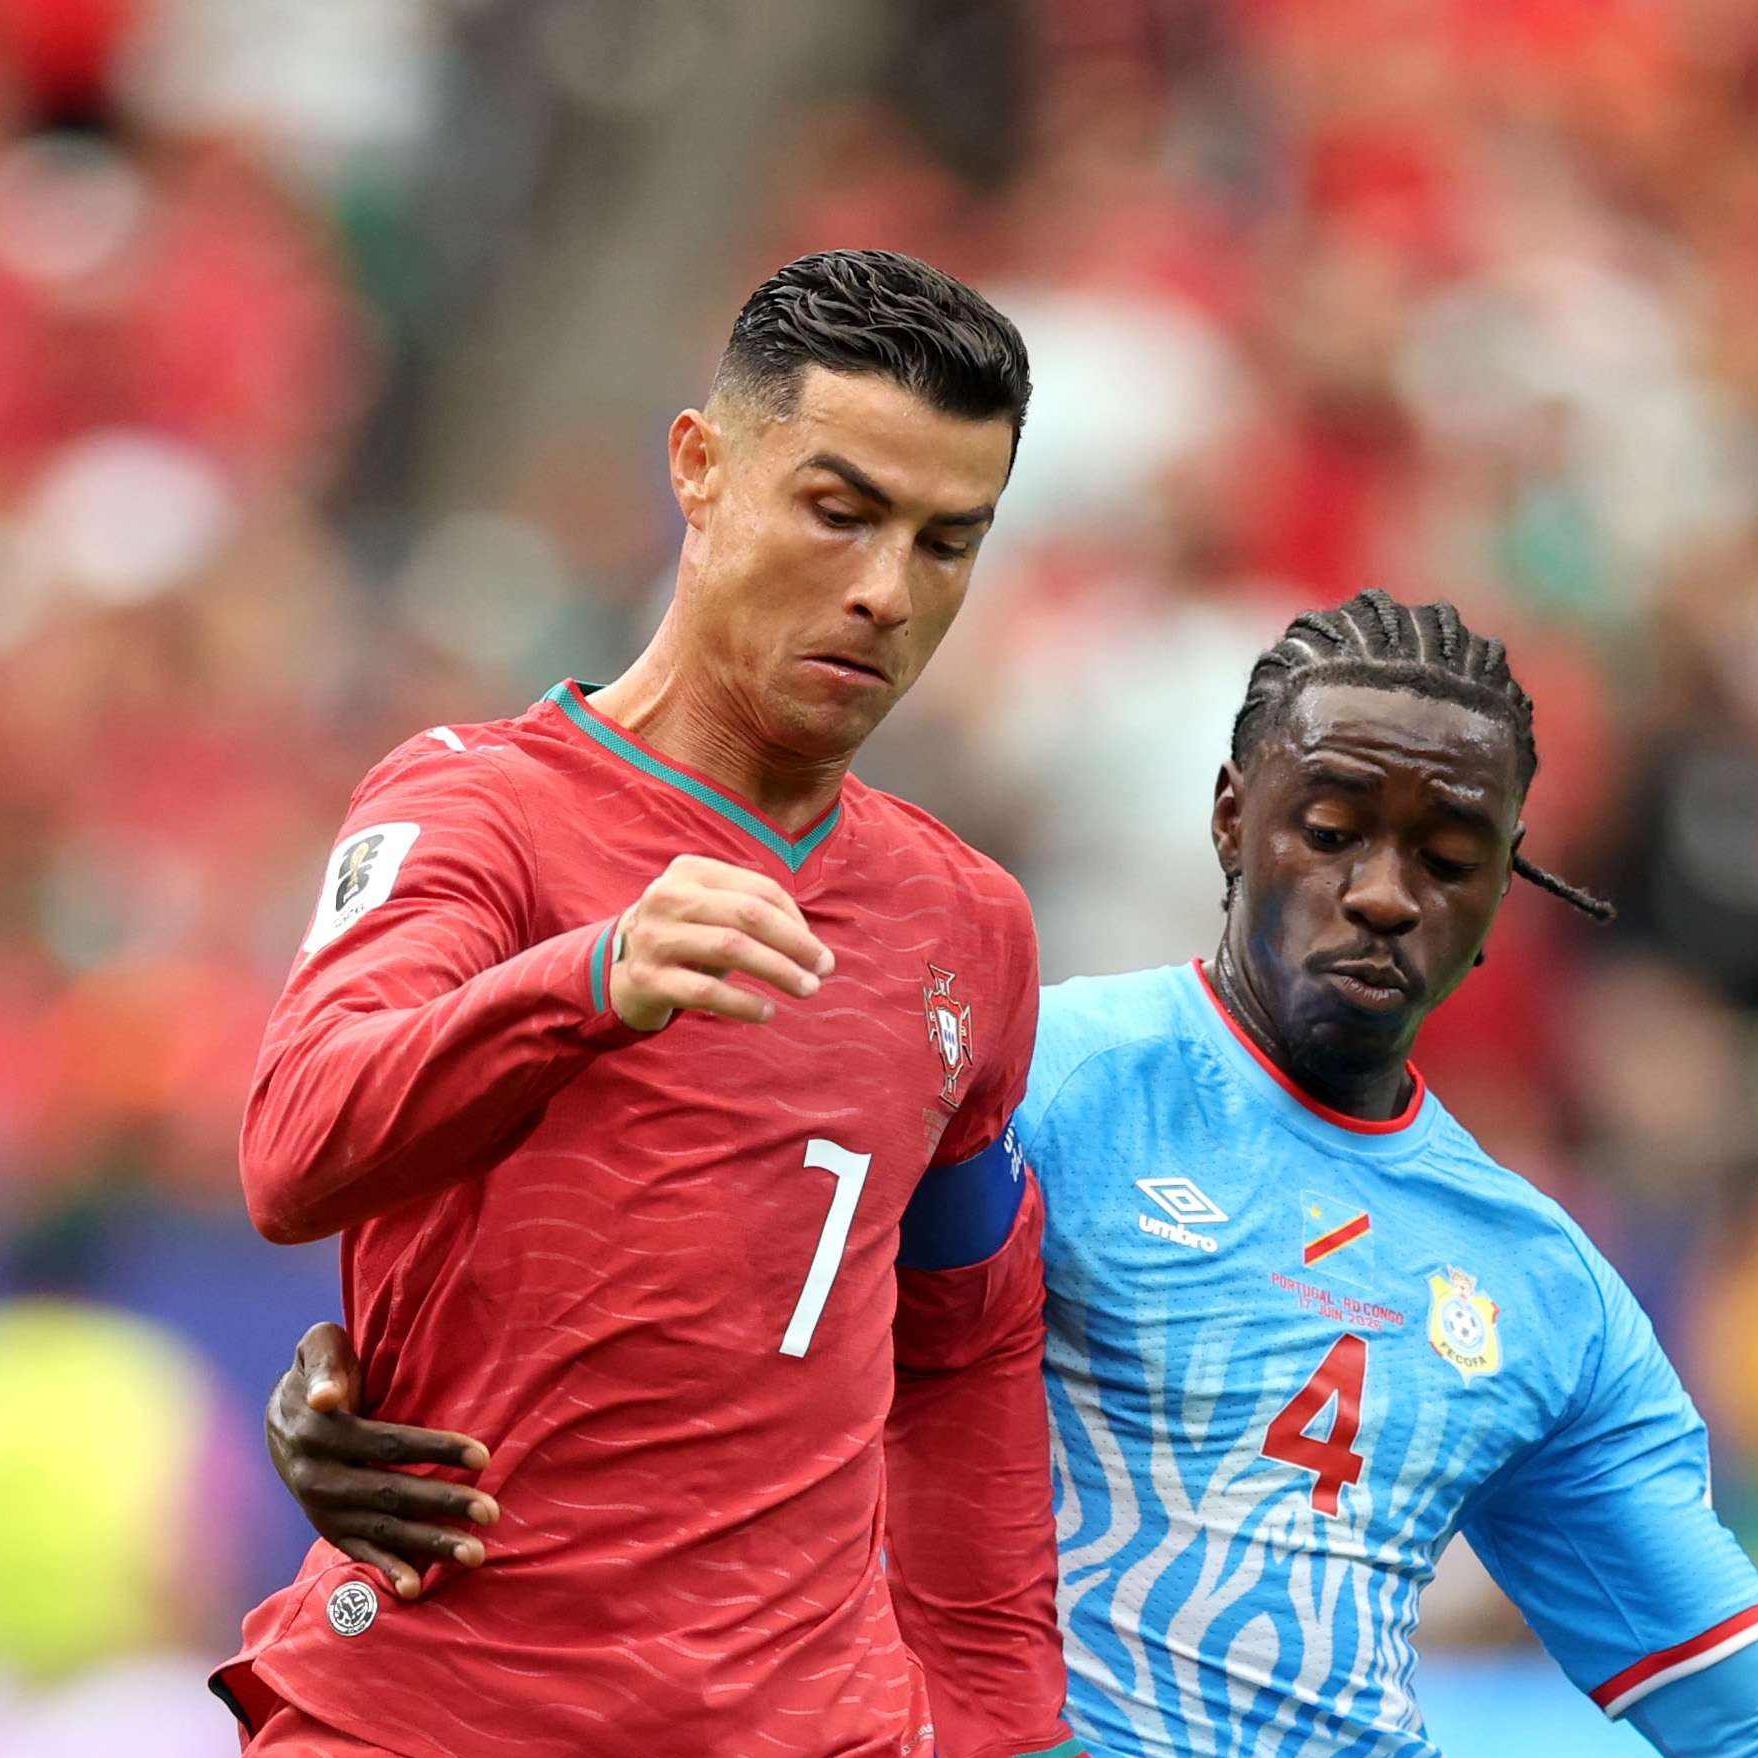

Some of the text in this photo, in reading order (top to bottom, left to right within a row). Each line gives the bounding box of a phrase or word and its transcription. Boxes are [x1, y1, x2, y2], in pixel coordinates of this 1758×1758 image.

[779, 1138, 872, 1358] 7
[1139, 1215, 1219, 1253] umbro
[1271, 1271, 1334, 1305] PORTUGAL
[1363, 1303, 1405, 1326] CONGO
[1259, 1331, 1369, 1519] 4
